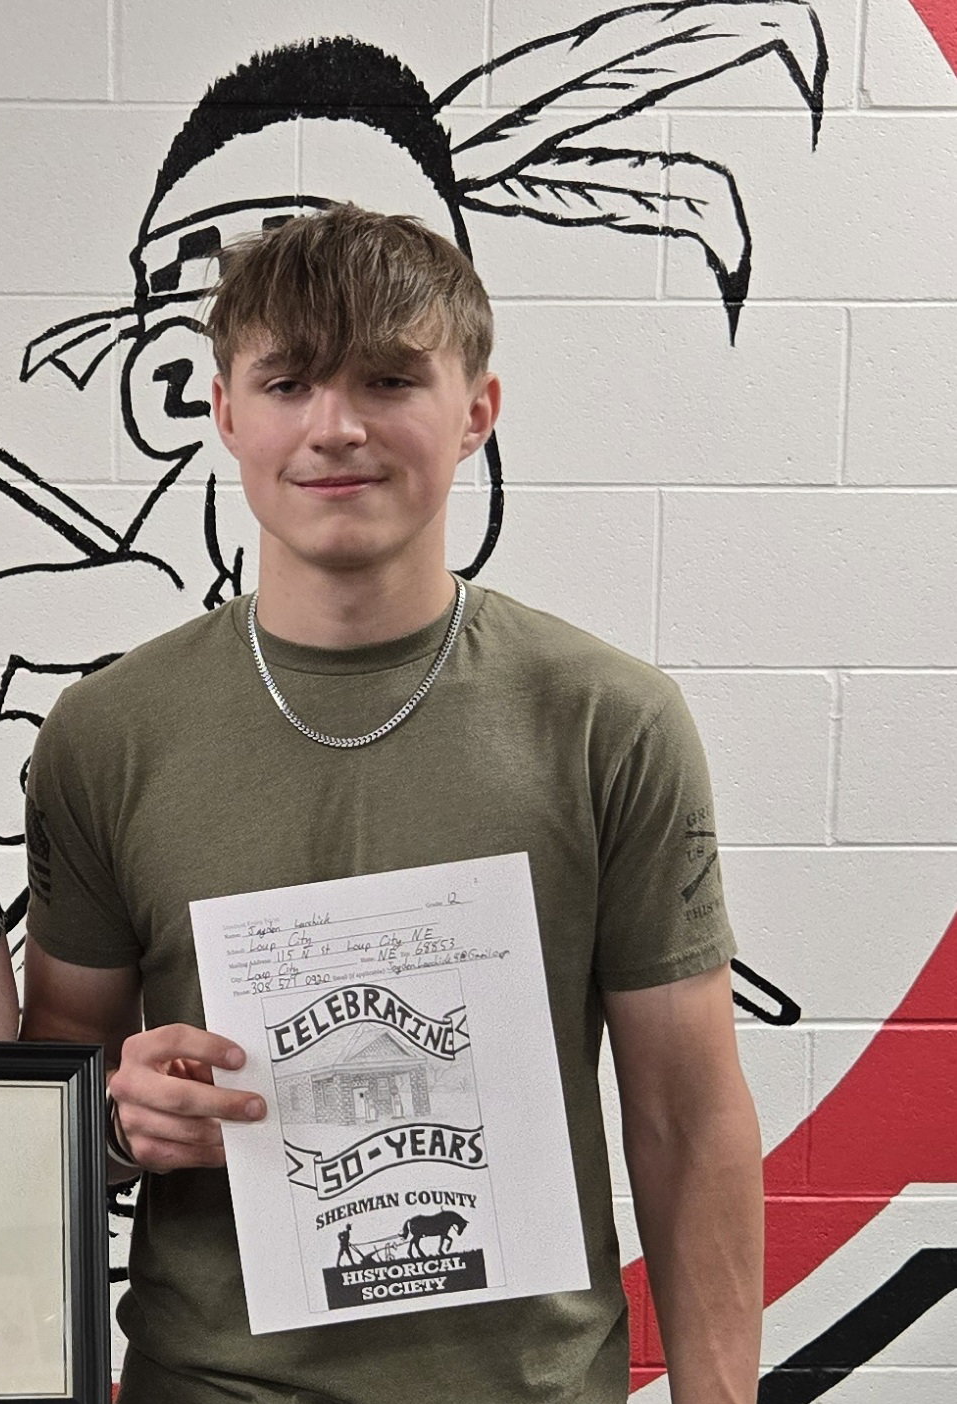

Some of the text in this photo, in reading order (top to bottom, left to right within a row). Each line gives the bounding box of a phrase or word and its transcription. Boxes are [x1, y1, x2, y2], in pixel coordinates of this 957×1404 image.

[274, 988, 454, 1055] CELEBRATING
[315, 1190, 477, 1230] SHERMAN COUNTY
[342, 1256, 466, 1286] HISTORICAL
[362, 1277, 448, 1300] SOCIETY
